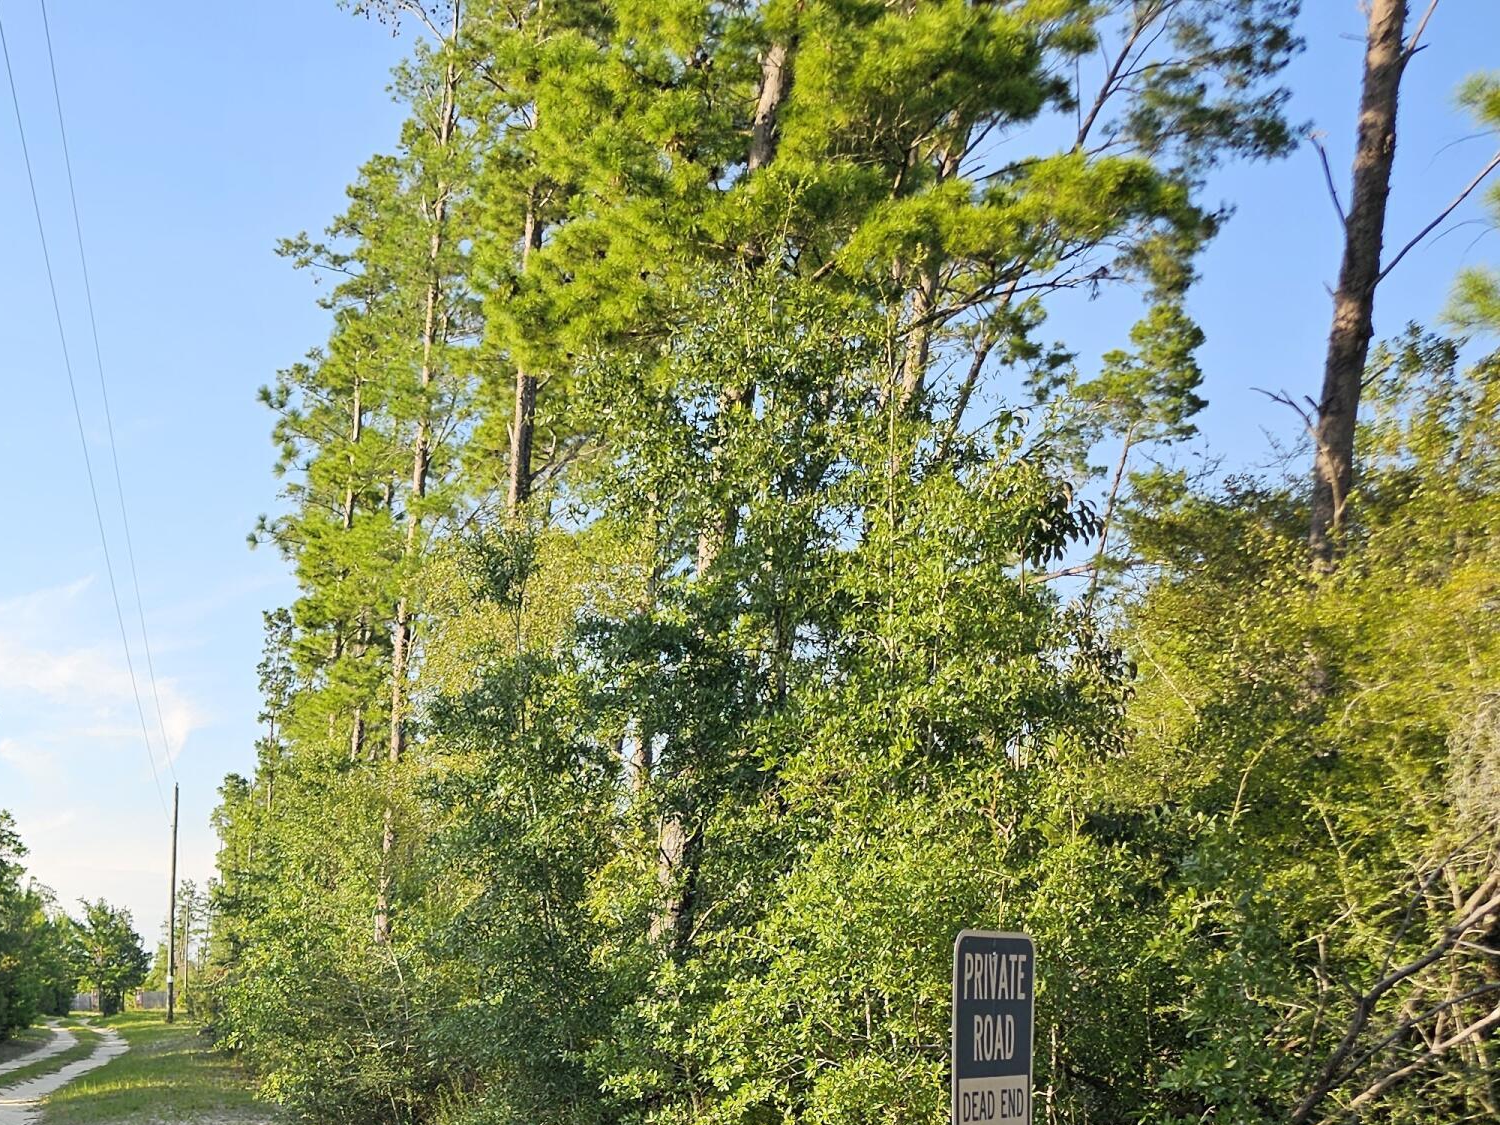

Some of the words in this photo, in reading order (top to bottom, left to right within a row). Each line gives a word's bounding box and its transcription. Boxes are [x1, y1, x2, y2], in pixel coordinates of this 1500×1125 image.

[963, 952, 1027, 1000] PRIVATE
[973, 1014, 1015, 1061] ROAD
[963, 1090, 995, 1122] DEAD
[1001, 1088, 1023, 1118] END
